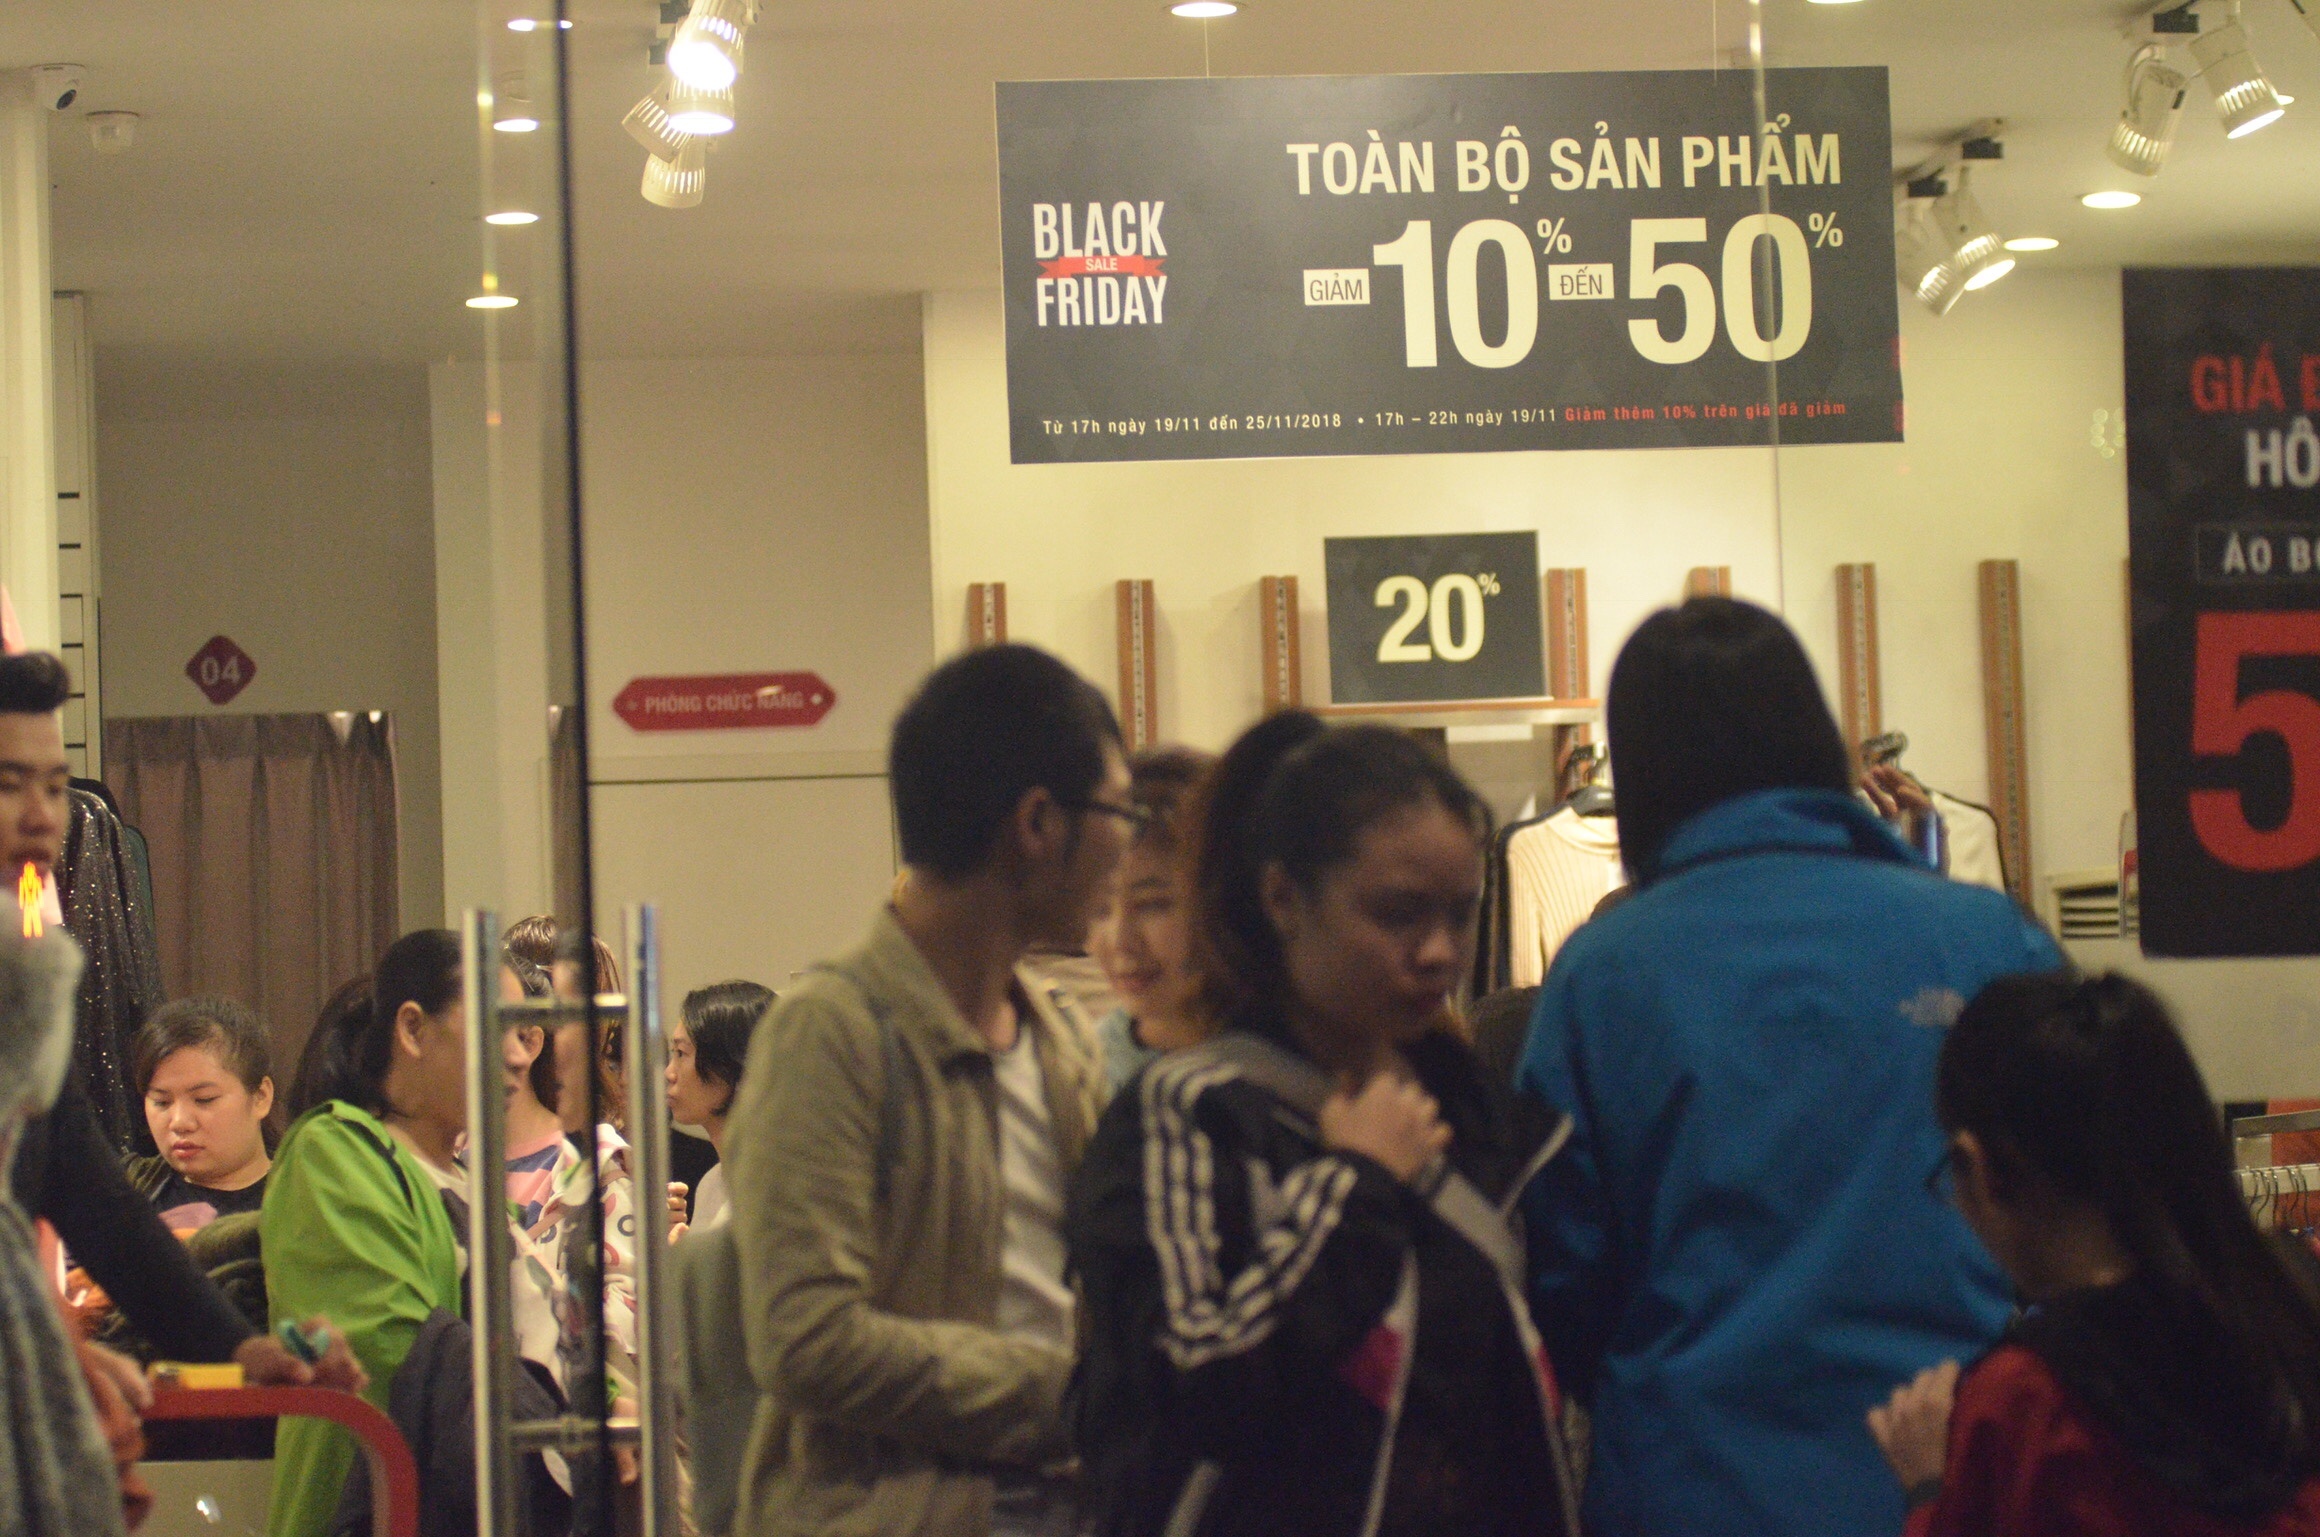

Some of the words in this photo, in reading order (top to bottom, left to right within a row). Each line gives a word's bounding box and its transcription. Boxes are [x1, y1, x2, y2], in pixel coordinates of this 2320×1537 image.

[1286, 129, 1435, 195] TOÀN
[1456, 125, 1530, 204] BỘ
[1550, 120, 1661, 191] SẢN
[1681, 113, 1841, 188] PHẨM
[1033, 201, 1168, 258] BLACK
[1085, 257, 1118, 272] SALE
[1309, 272, 1364, 302] GIẢM
[1560, 266, 1603, 296] ĐẾN
[1036, 275, 1168, 327] FRIDAY
[2192, 342, 2286, 412] GIÁ
[1043, 419, 1063, 434] Từ
[1072, 419, 1100, 433] 17h
[1108, 417, 1146, 435] ngày
[1155, 417, 1200, 431] 19/11
[1209, 414, 1238, 430] đến
[1246, 413, 1342, 429] 25/11/2018
[1375, 412, 1404, 426] 17h
[1428, 410, 1458, 425] 22h
[1466, 409, 1503, 426] ngày
[1511, 409, 1556, 423] 19/11
[1613, 406, 1654, 419] thêm
[1662, 405, 1697, 419] 10%
[1704, 404, 1738, 418] trên
[1745, 402, 1771, 419] giá
[1778, 402, 1798, 416] đã
[2223, 530, 2273, 575] ÁO
[201, 655, 241, 686] 04
